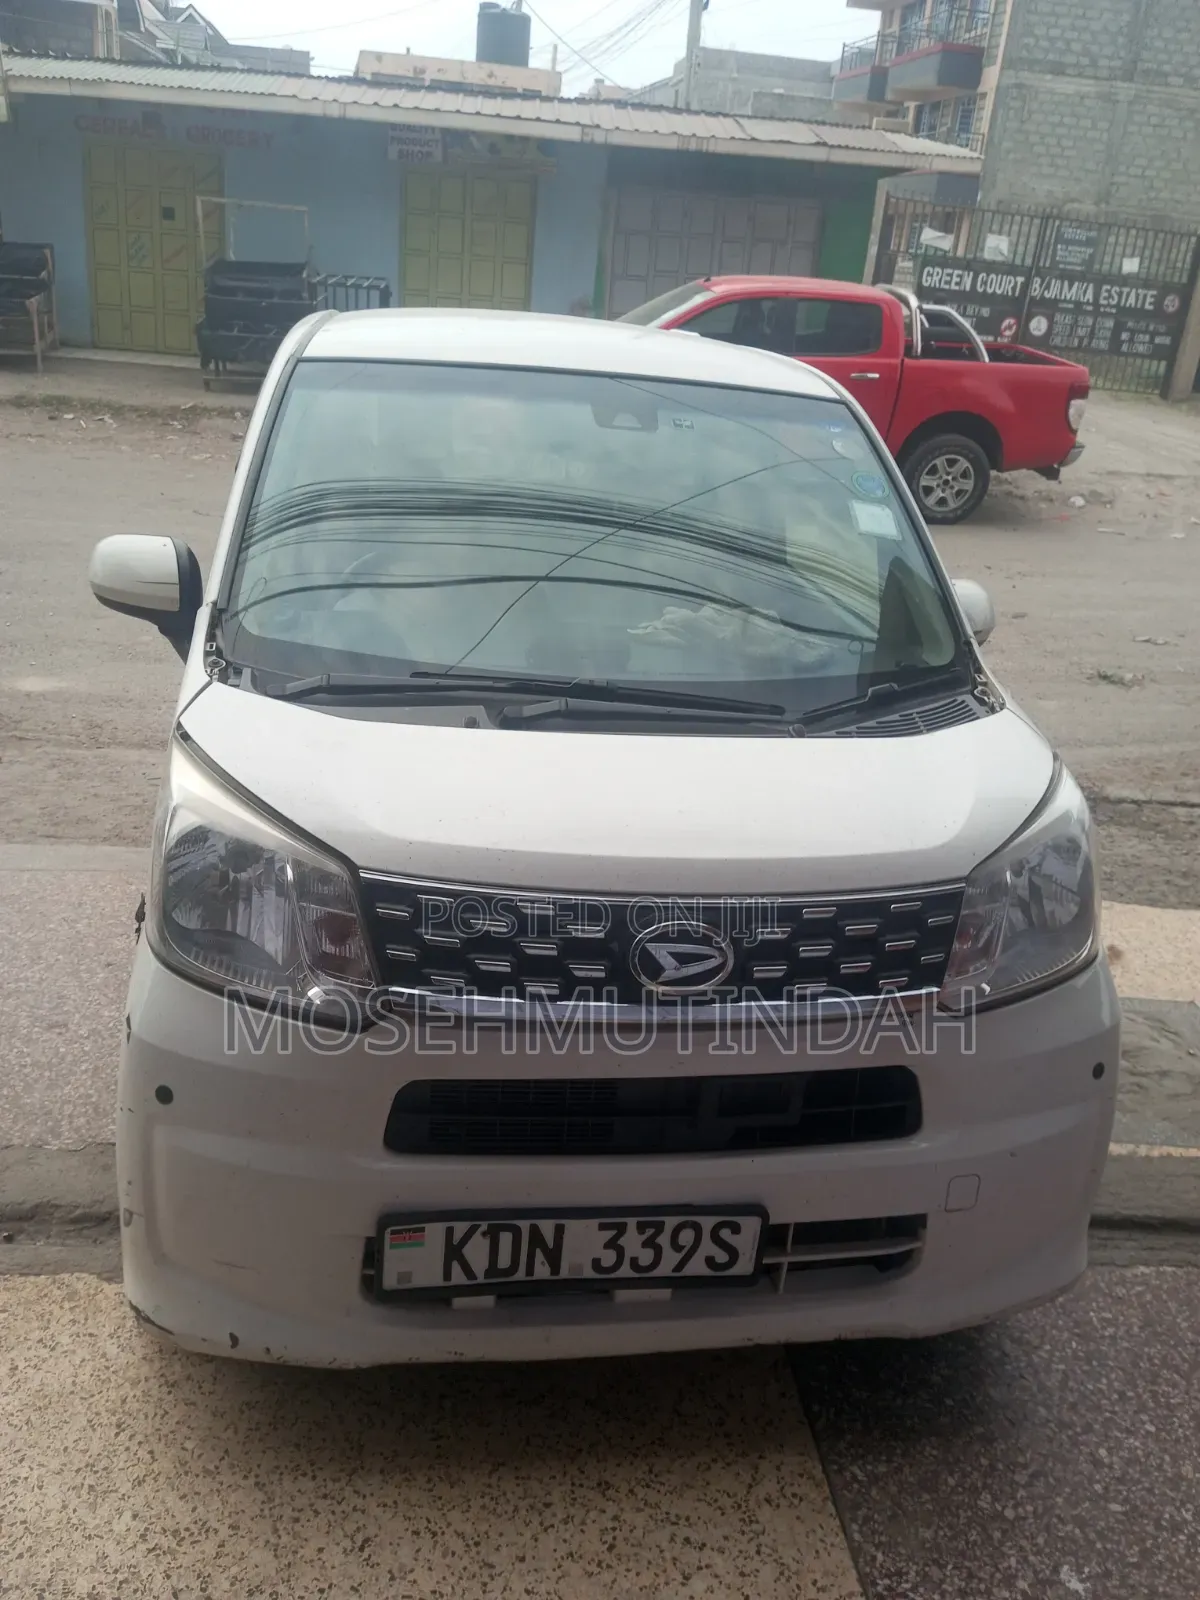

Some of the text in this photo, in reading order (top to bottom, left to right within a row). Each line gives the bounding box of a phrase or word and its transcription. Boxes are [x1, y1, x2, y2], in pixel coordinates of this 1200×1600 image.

[186, 125, 274, 149] GROCERY
[390, 136, 440, 149] PRODUCT
[397, 149, 434, 162] SHOP
[922, 266, 973, 292] GREEN
[976, 273, 1025, 297] COURT
[1099, 284, 1157, 310] ESTATE
[442, 1223, 566, 1282] KDN
[591, 1220, 742, 1275] 339S
